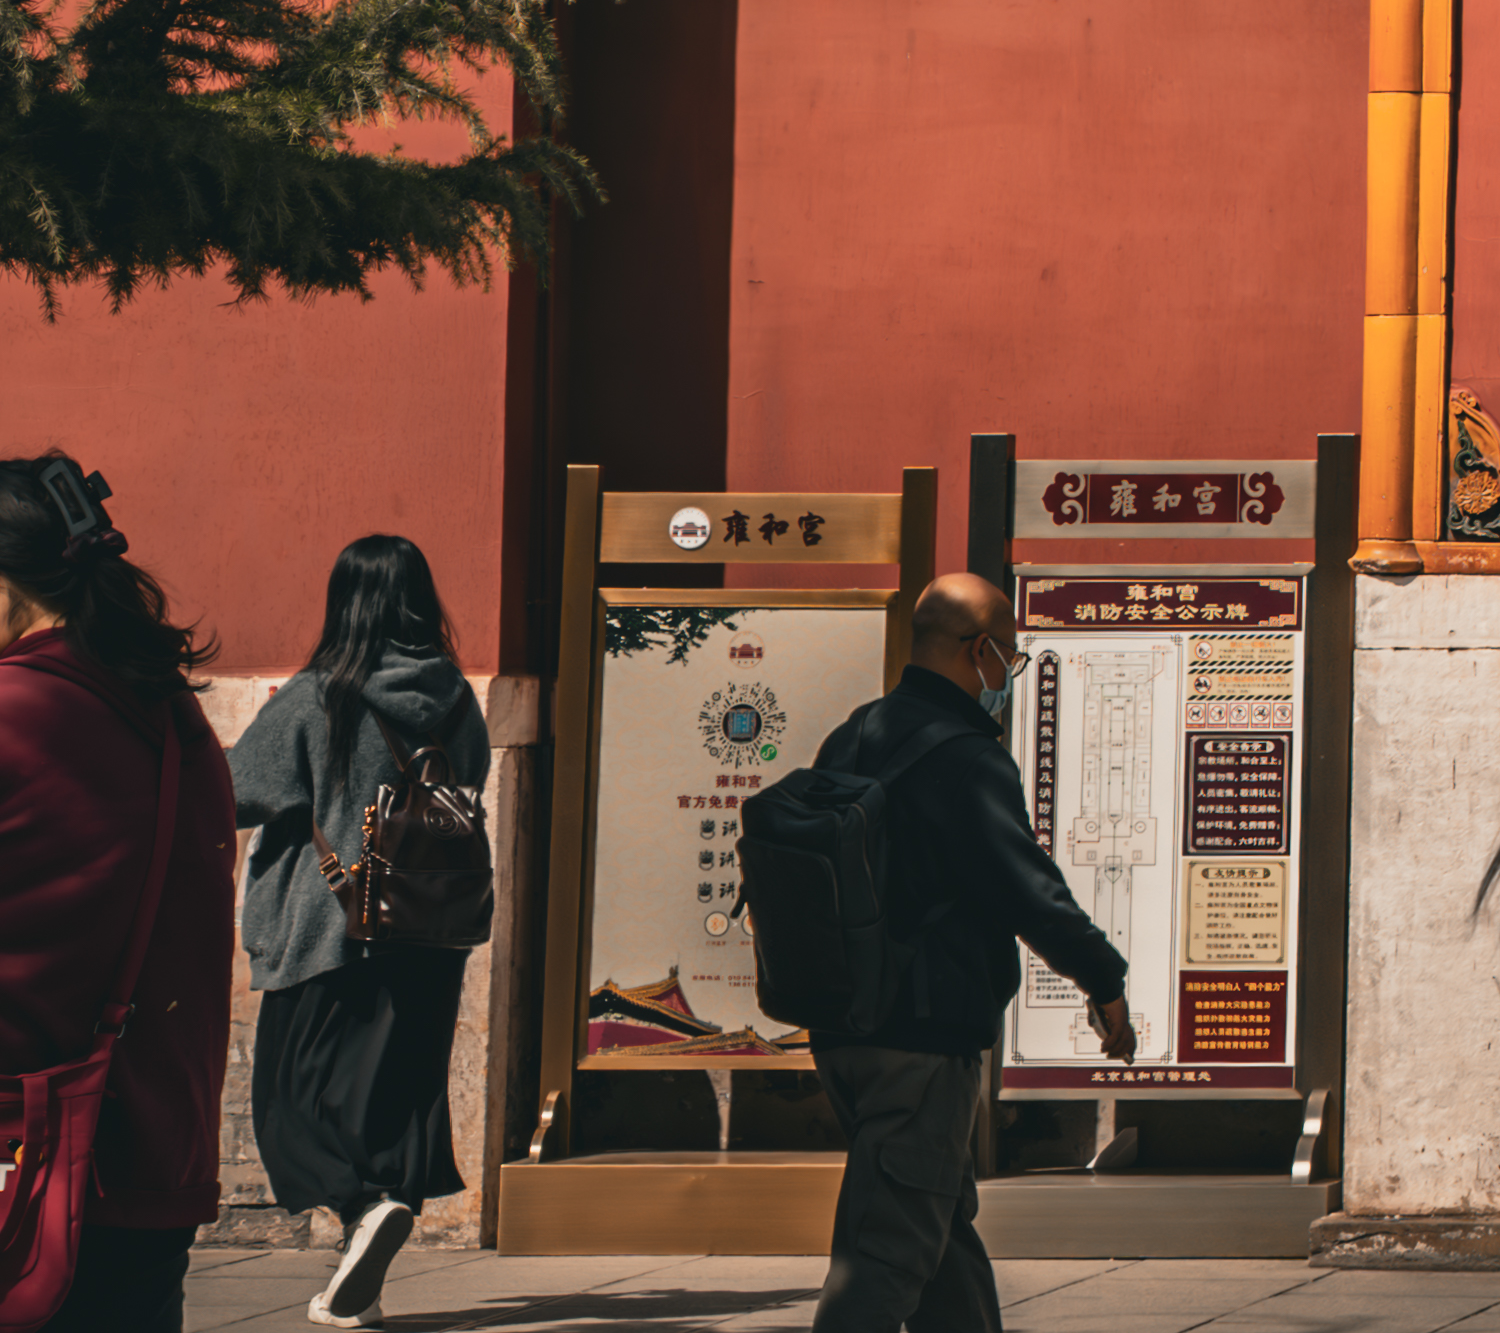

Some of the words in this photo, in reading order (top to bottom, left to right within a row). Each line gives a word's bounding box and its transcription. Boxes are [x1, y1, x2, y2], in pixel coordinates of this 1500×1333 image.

[1110, 480, 1222, 518] 雍和宫
[721, 509, 826, 547] 雍和宫
[1125, 584, 1200, 602] 雍和宫
[1074, 603, 1250, 621] 消防安全公示牌
[1036, 664, 1056, 856] 雍和宫疏散路线及消防设施
[715, 774, 762, 788] 雍和宫
[677, 795, 750, 809] 官方免费
[1090, 1071, 1212, 1082] 北京雍和宫管理处
